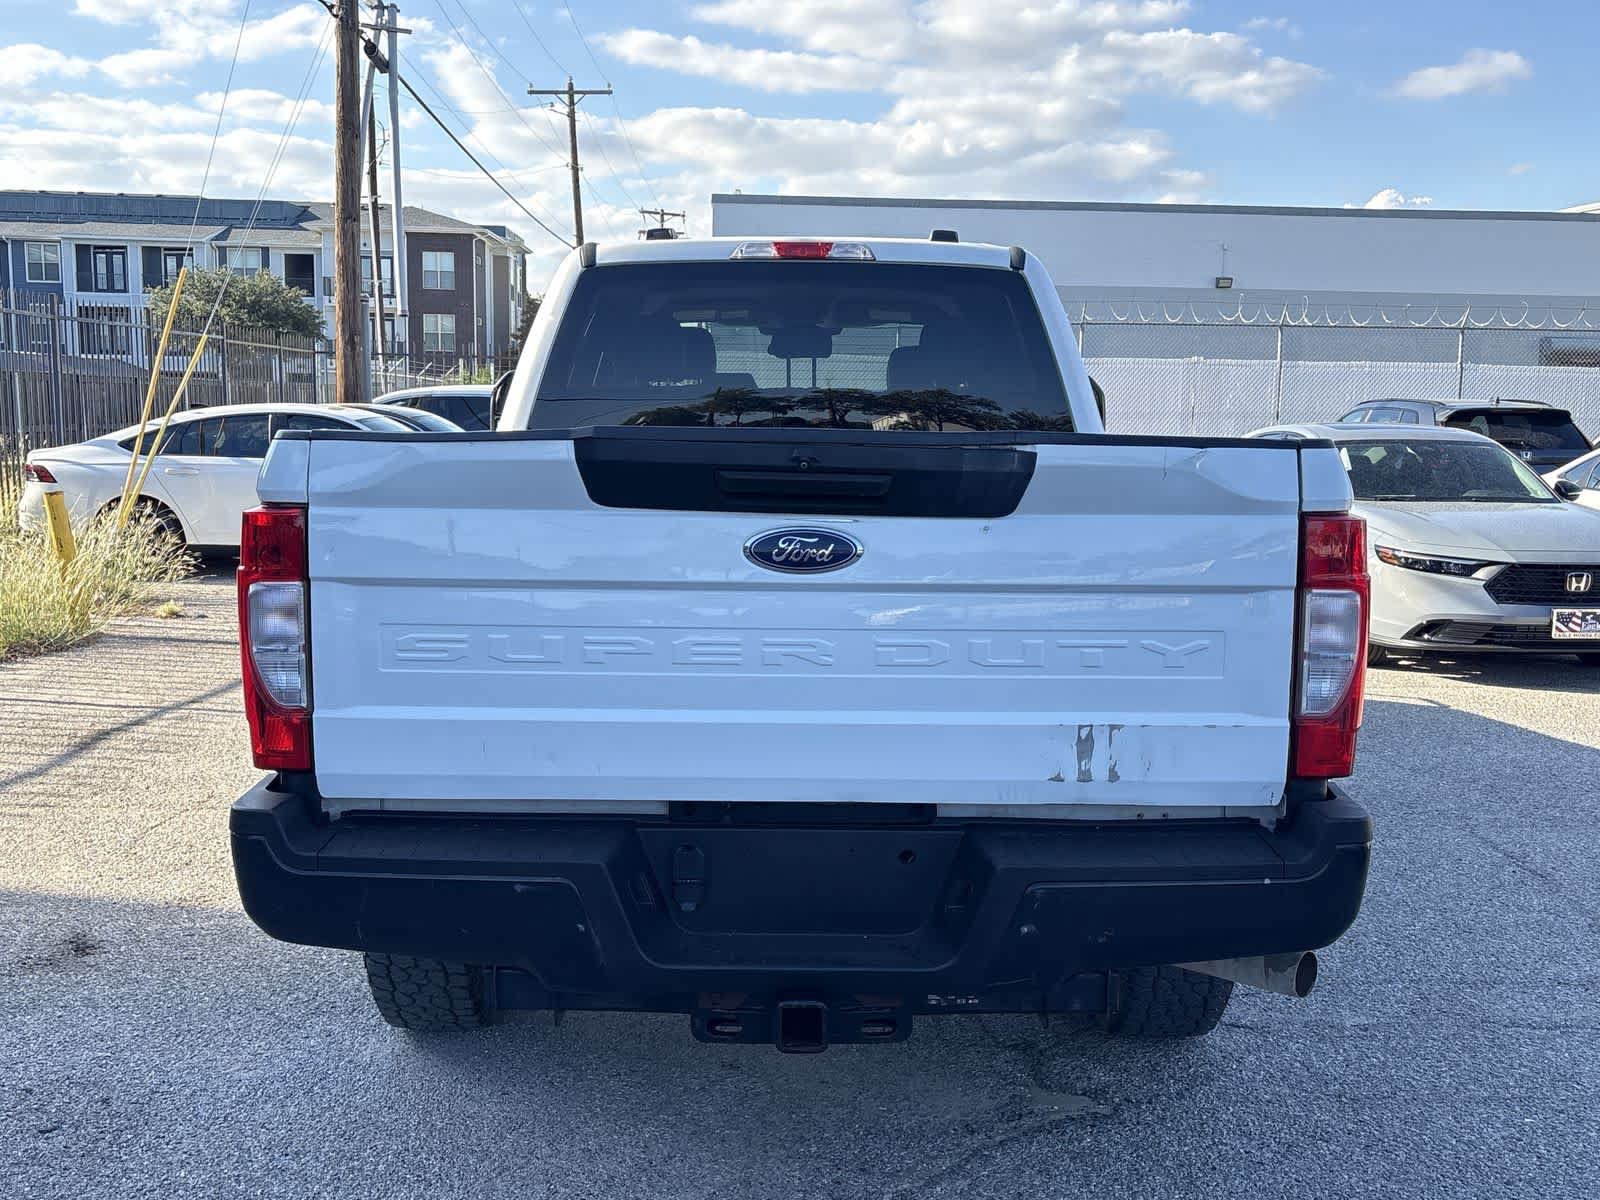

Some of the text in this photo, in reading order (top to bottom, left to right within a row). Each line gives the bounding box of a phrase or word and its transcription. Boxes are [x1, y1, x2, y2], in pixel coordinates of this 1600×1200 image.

[772, 536, 835, 562] Ford
[395, 633, 1211, 668] SUPER DUTY
